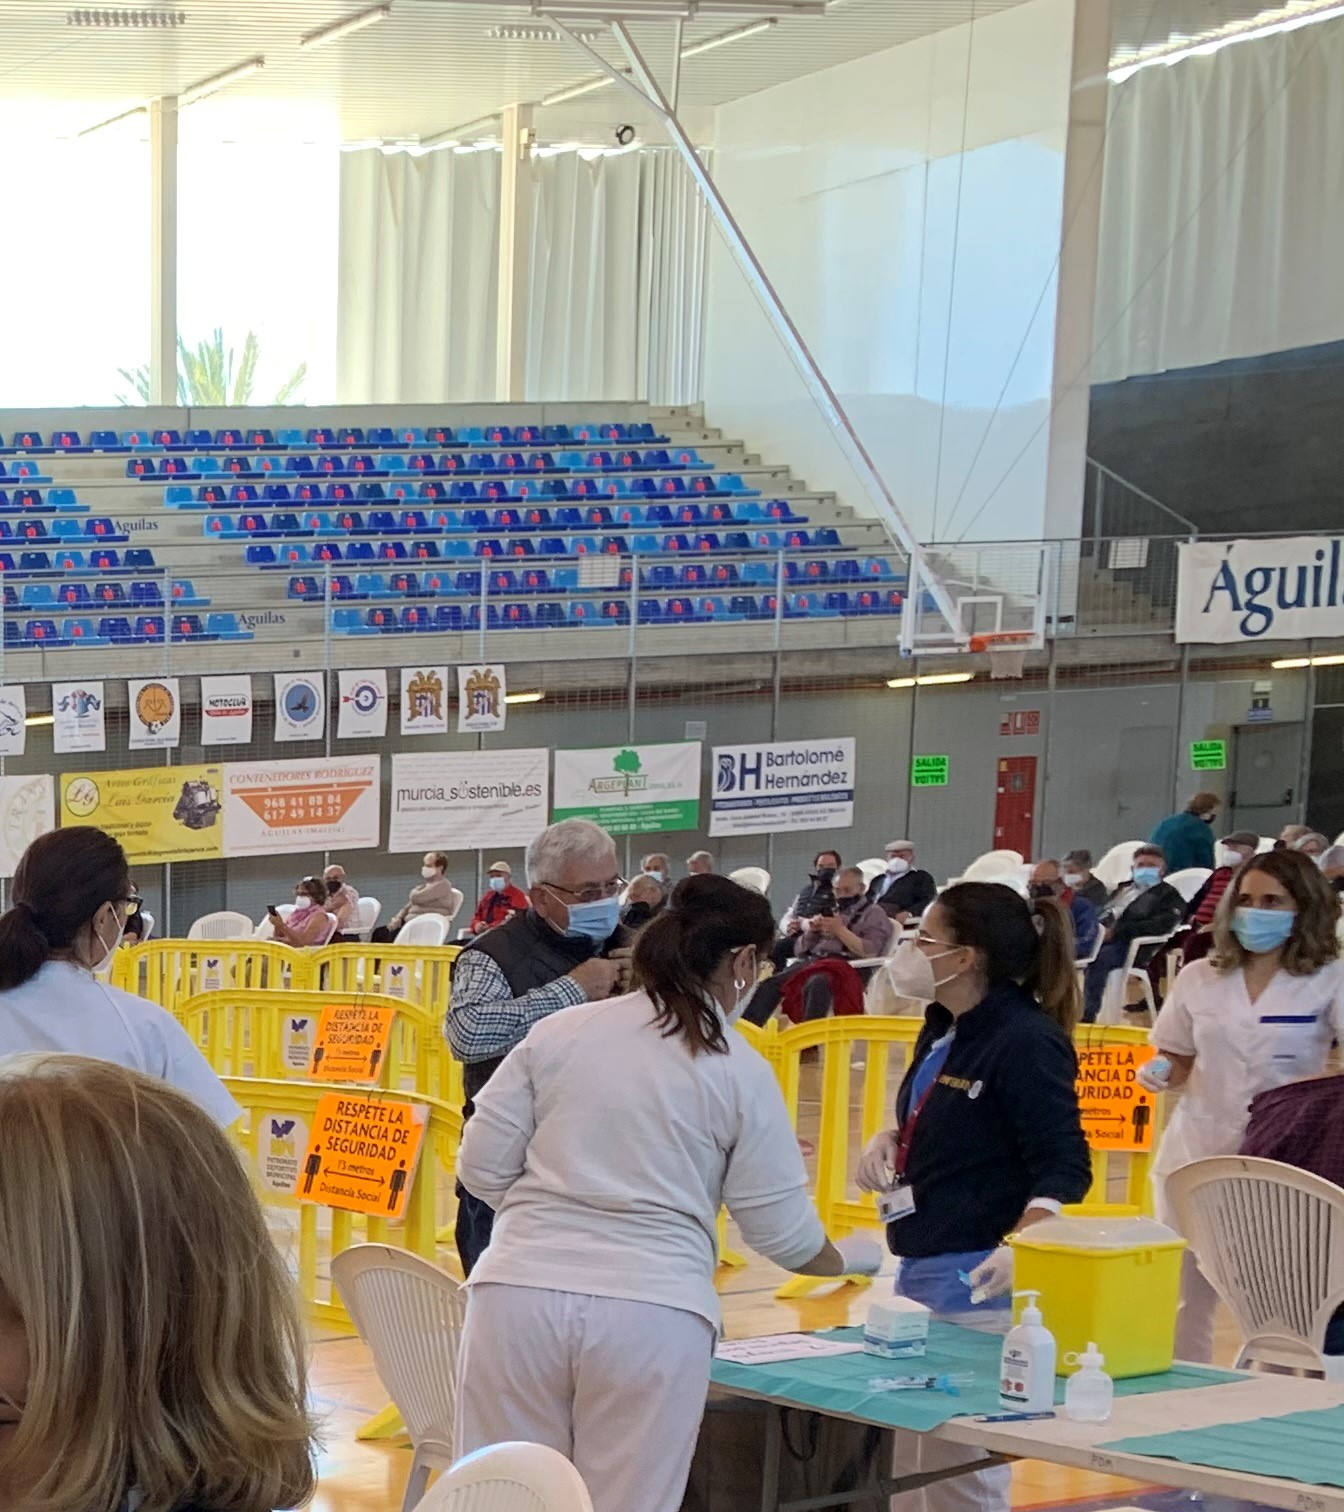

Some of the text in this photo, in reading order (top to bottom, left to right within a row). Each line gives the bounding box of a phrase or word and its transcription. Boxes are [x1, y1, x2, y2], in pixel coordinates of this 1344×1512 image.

[1201, 540, 1344, 637] Águil
[1192, 742, 1224, 752] SALIDA
[766, 745, 845, 768] Bartolomé
[915, 756, 947, 768] SALIDA
[229, 770, 311, 784] CONTENEDORES
[765, 770, 848, 789] Hernández
[263, 797, 286, 809] 968
[289, 796, 303, 807] 41
[263, 806, 342, 821] 617 49 14 37
[1079, 1051, 1135, 1066] PETE LA
[1077, 1069, 1136, 1082] ANCIA D
[1077, 1085, 1134, 1100] URIDAD
[336, 1100, 404, 1125] RESPETE LA
[323, 1117, 410, 1145] DISTANCIA DE
[325, 1135, 397, 1161] SEGURIDAD
[349, 1164, 375, 1176] metros
[319, 1181, 381, 1203] Distancia Social
